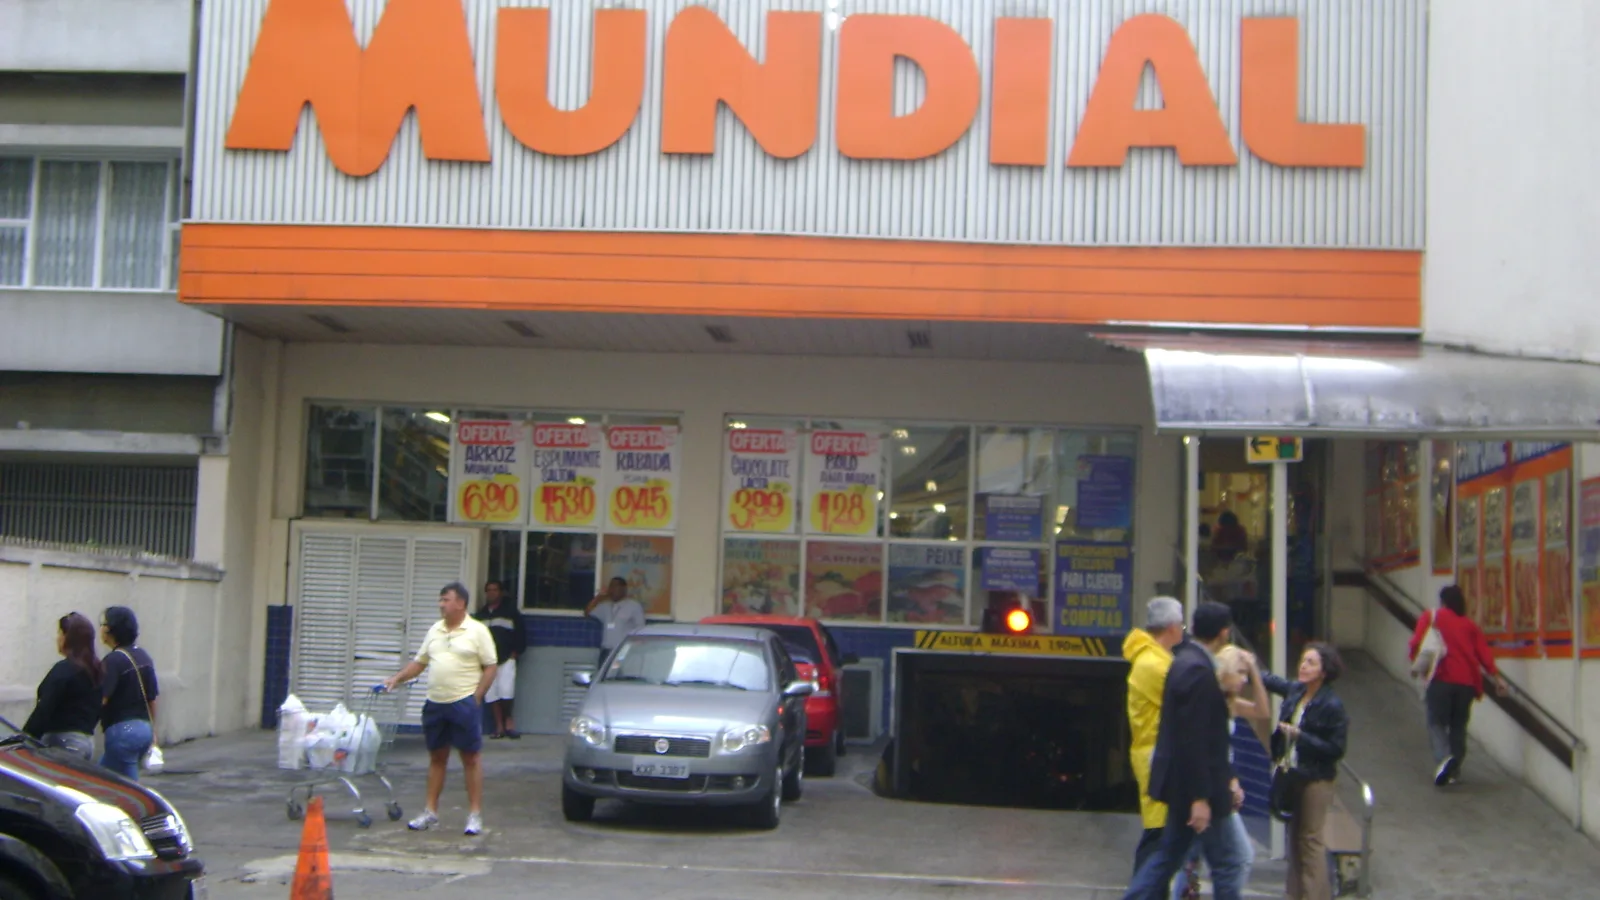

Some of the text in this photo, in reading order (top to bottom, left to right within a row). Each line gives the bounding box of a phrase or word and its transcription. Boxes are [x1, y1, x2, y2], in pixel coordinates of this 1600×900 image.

[224, 0, 1366, 178] MUNDIAL
[459, 425, 514, 442] OFERTA
[534, 427, 589, 446] OFERTA
[610, 431, 666, 447] OFERTA
[730, 434, 785, 451] OFERTA
[813, 435, 869, 452] OFERTA
[465, 446, 516, 463] ARROZ
[534, 450, 601, 468] ESPUMANTE
[731, 455, 790, 478] CHOCOLATE
[926, 547, 964, 566] PEIXE
[940, 635, 983, 648] ALTURA
